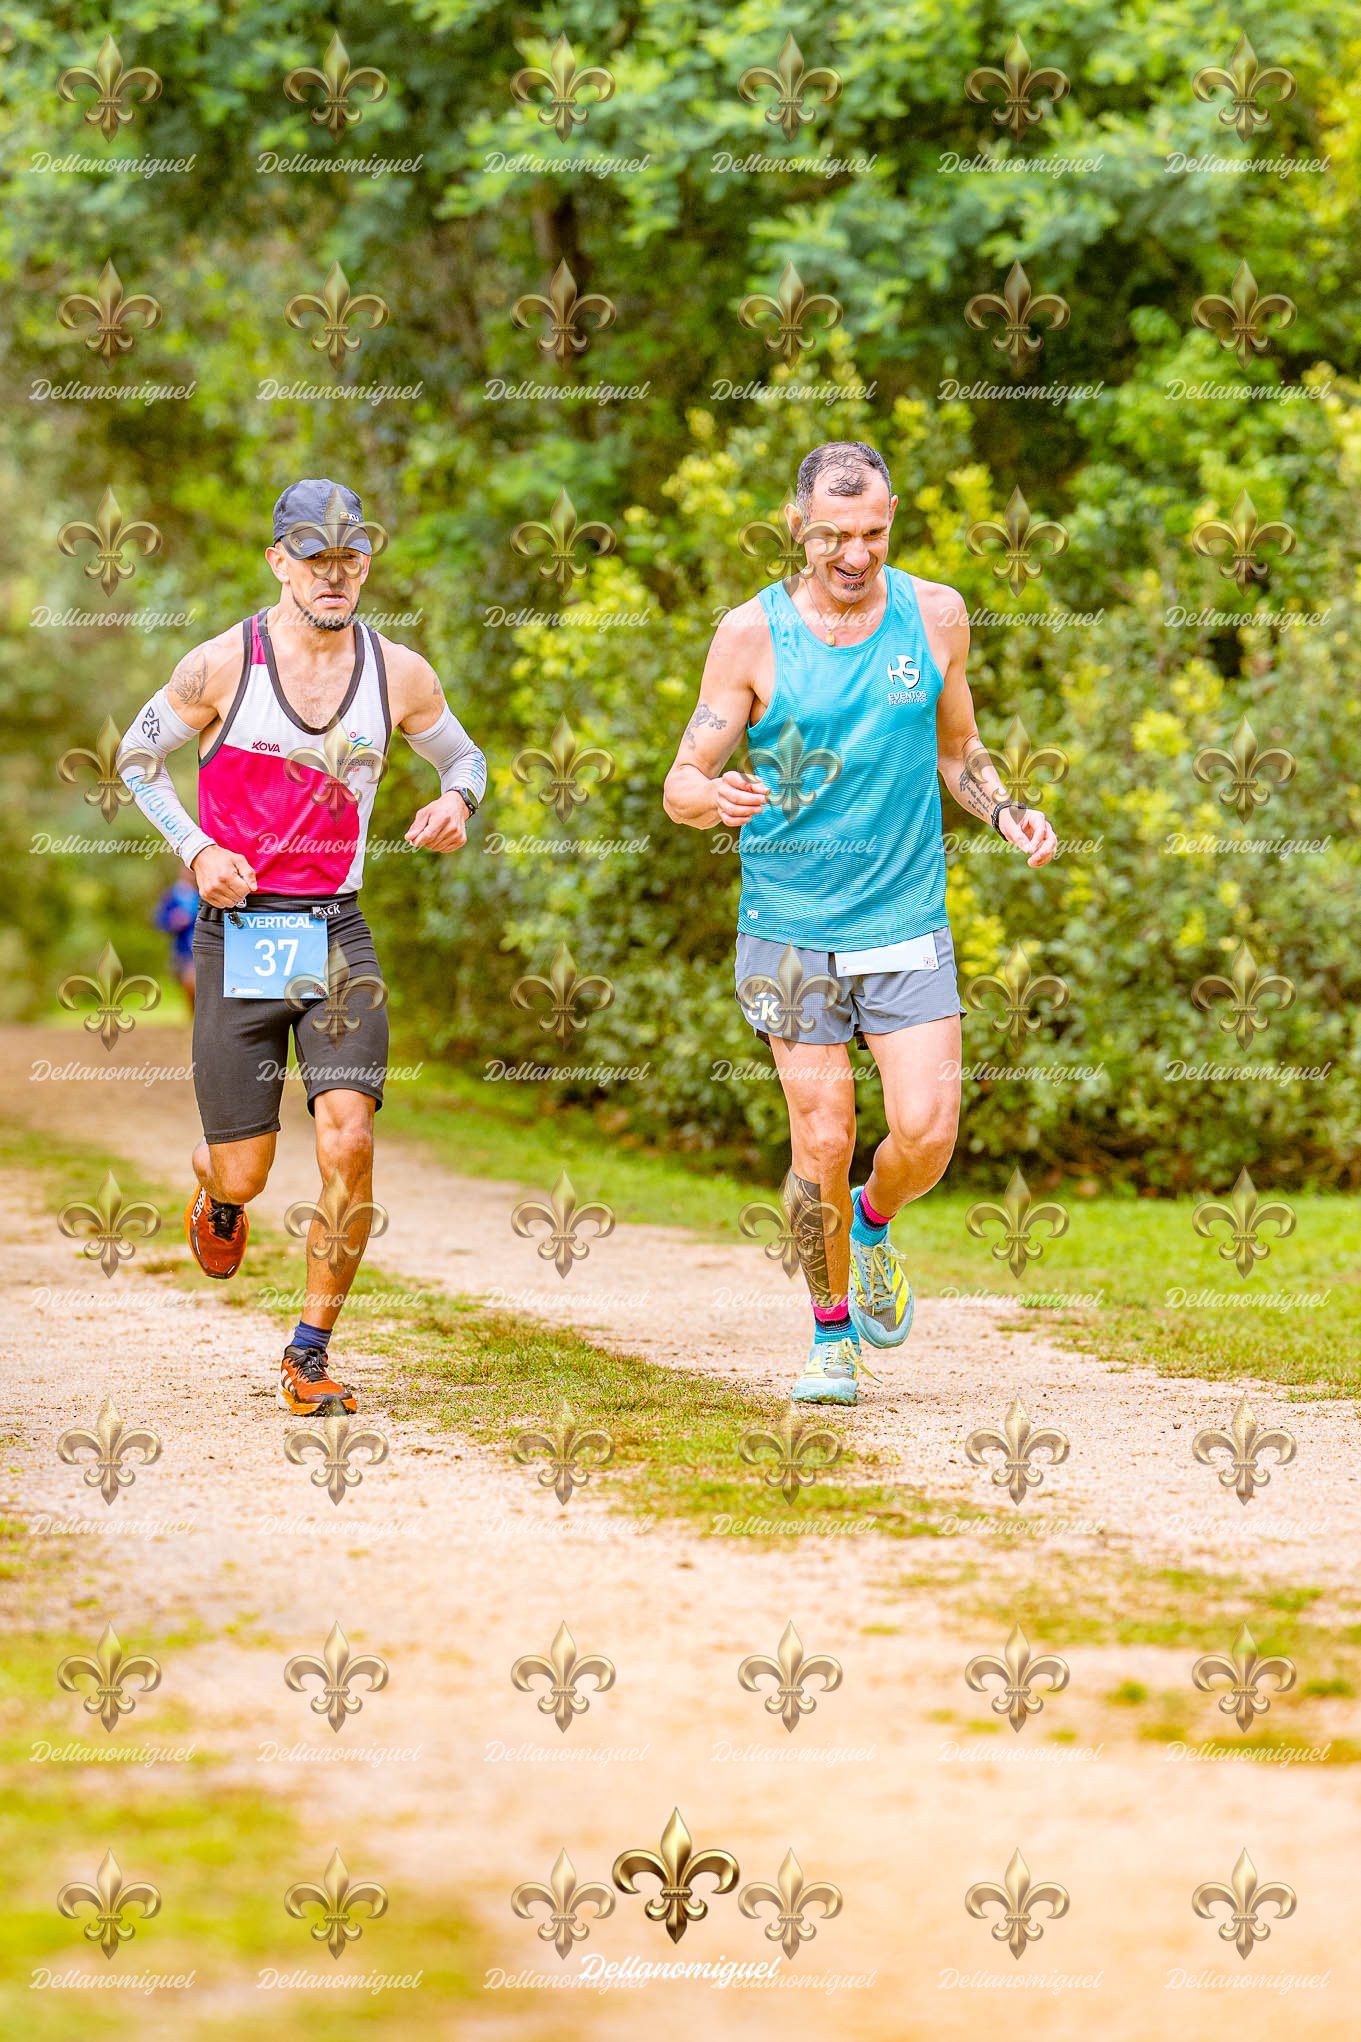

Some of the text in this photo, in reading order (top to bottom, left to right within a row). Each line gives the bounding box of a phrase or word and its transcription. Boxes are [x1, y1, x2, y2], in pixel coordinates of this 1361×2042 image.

[888, 690, 928, 700] EVENTOS
[252, 740, 280, 753] KOVA
[246, 916, 314, 929] VERTICAL
[254, 938, 299, 977] 37
